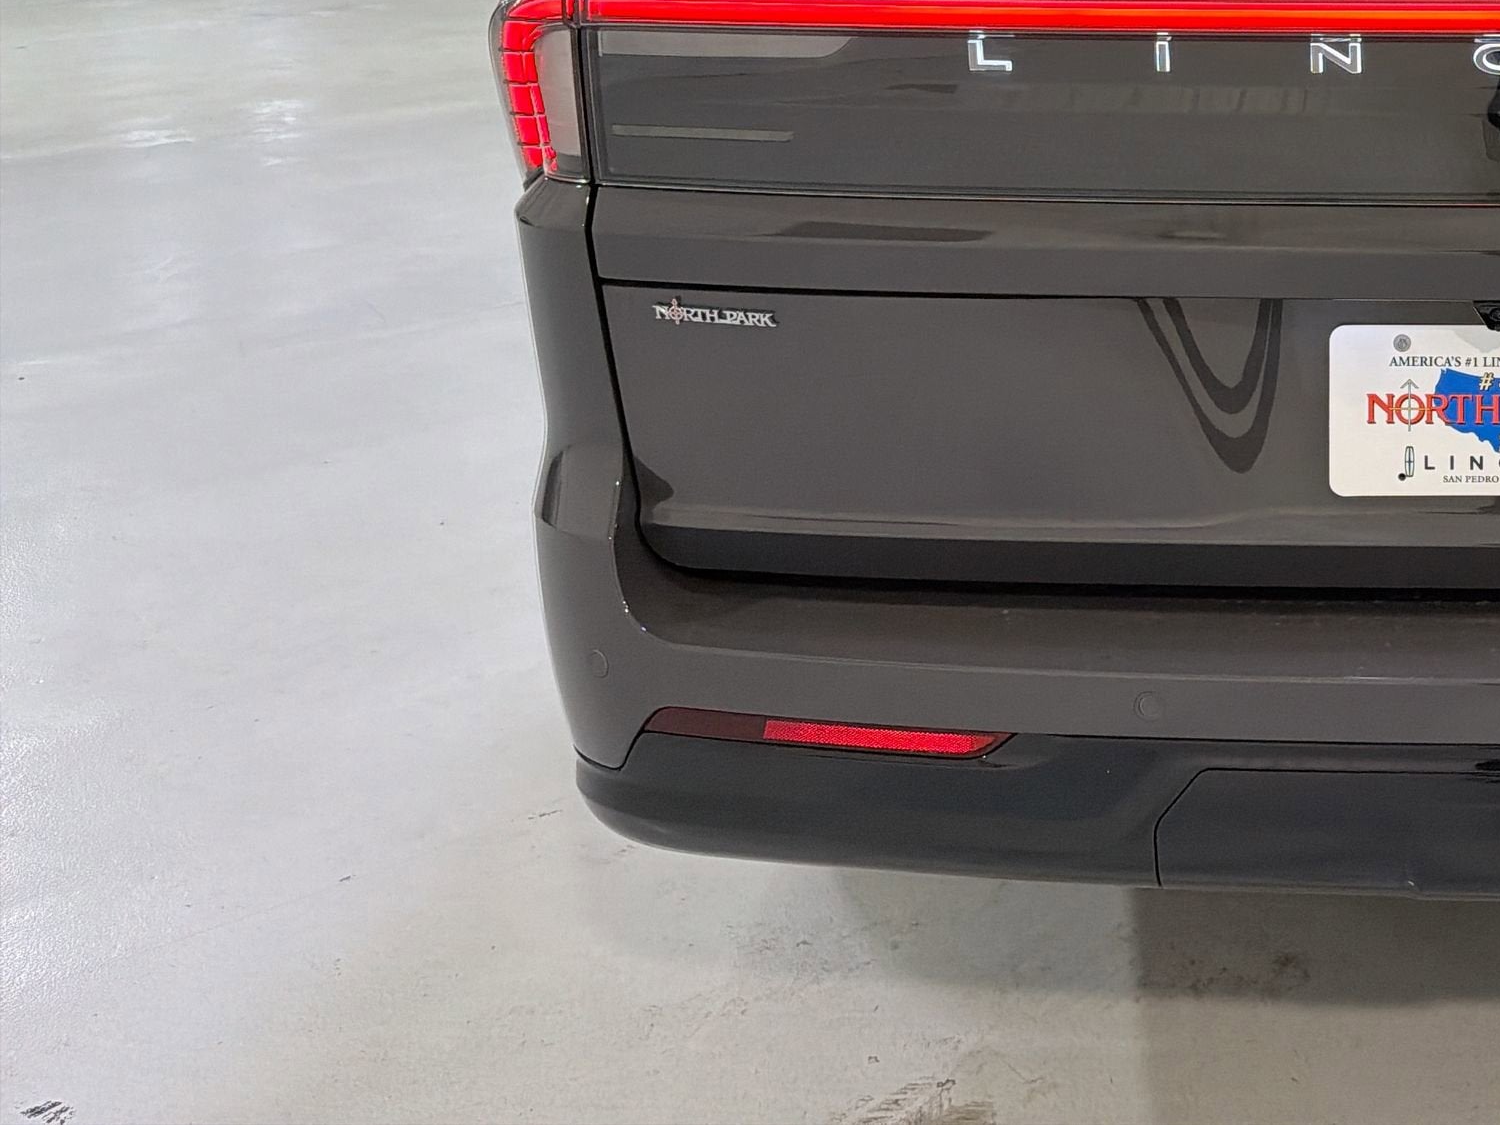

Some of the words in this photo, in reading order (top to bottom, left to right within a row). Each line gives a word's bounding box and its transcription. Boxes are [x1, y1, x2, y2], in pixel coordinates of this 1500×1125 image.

[652, 304, 719, 324] NORTH
[722, 309, 777, 327] PARK
[1389, 356, 1461, 367] AMERICA'S
[1465, 357, 1478, 367] #1
[1366, 393, 1500, 425] NORTH
[1443, 475, 1462, 483] SAN
[1465, 475, 1500, 484] PEDRO
